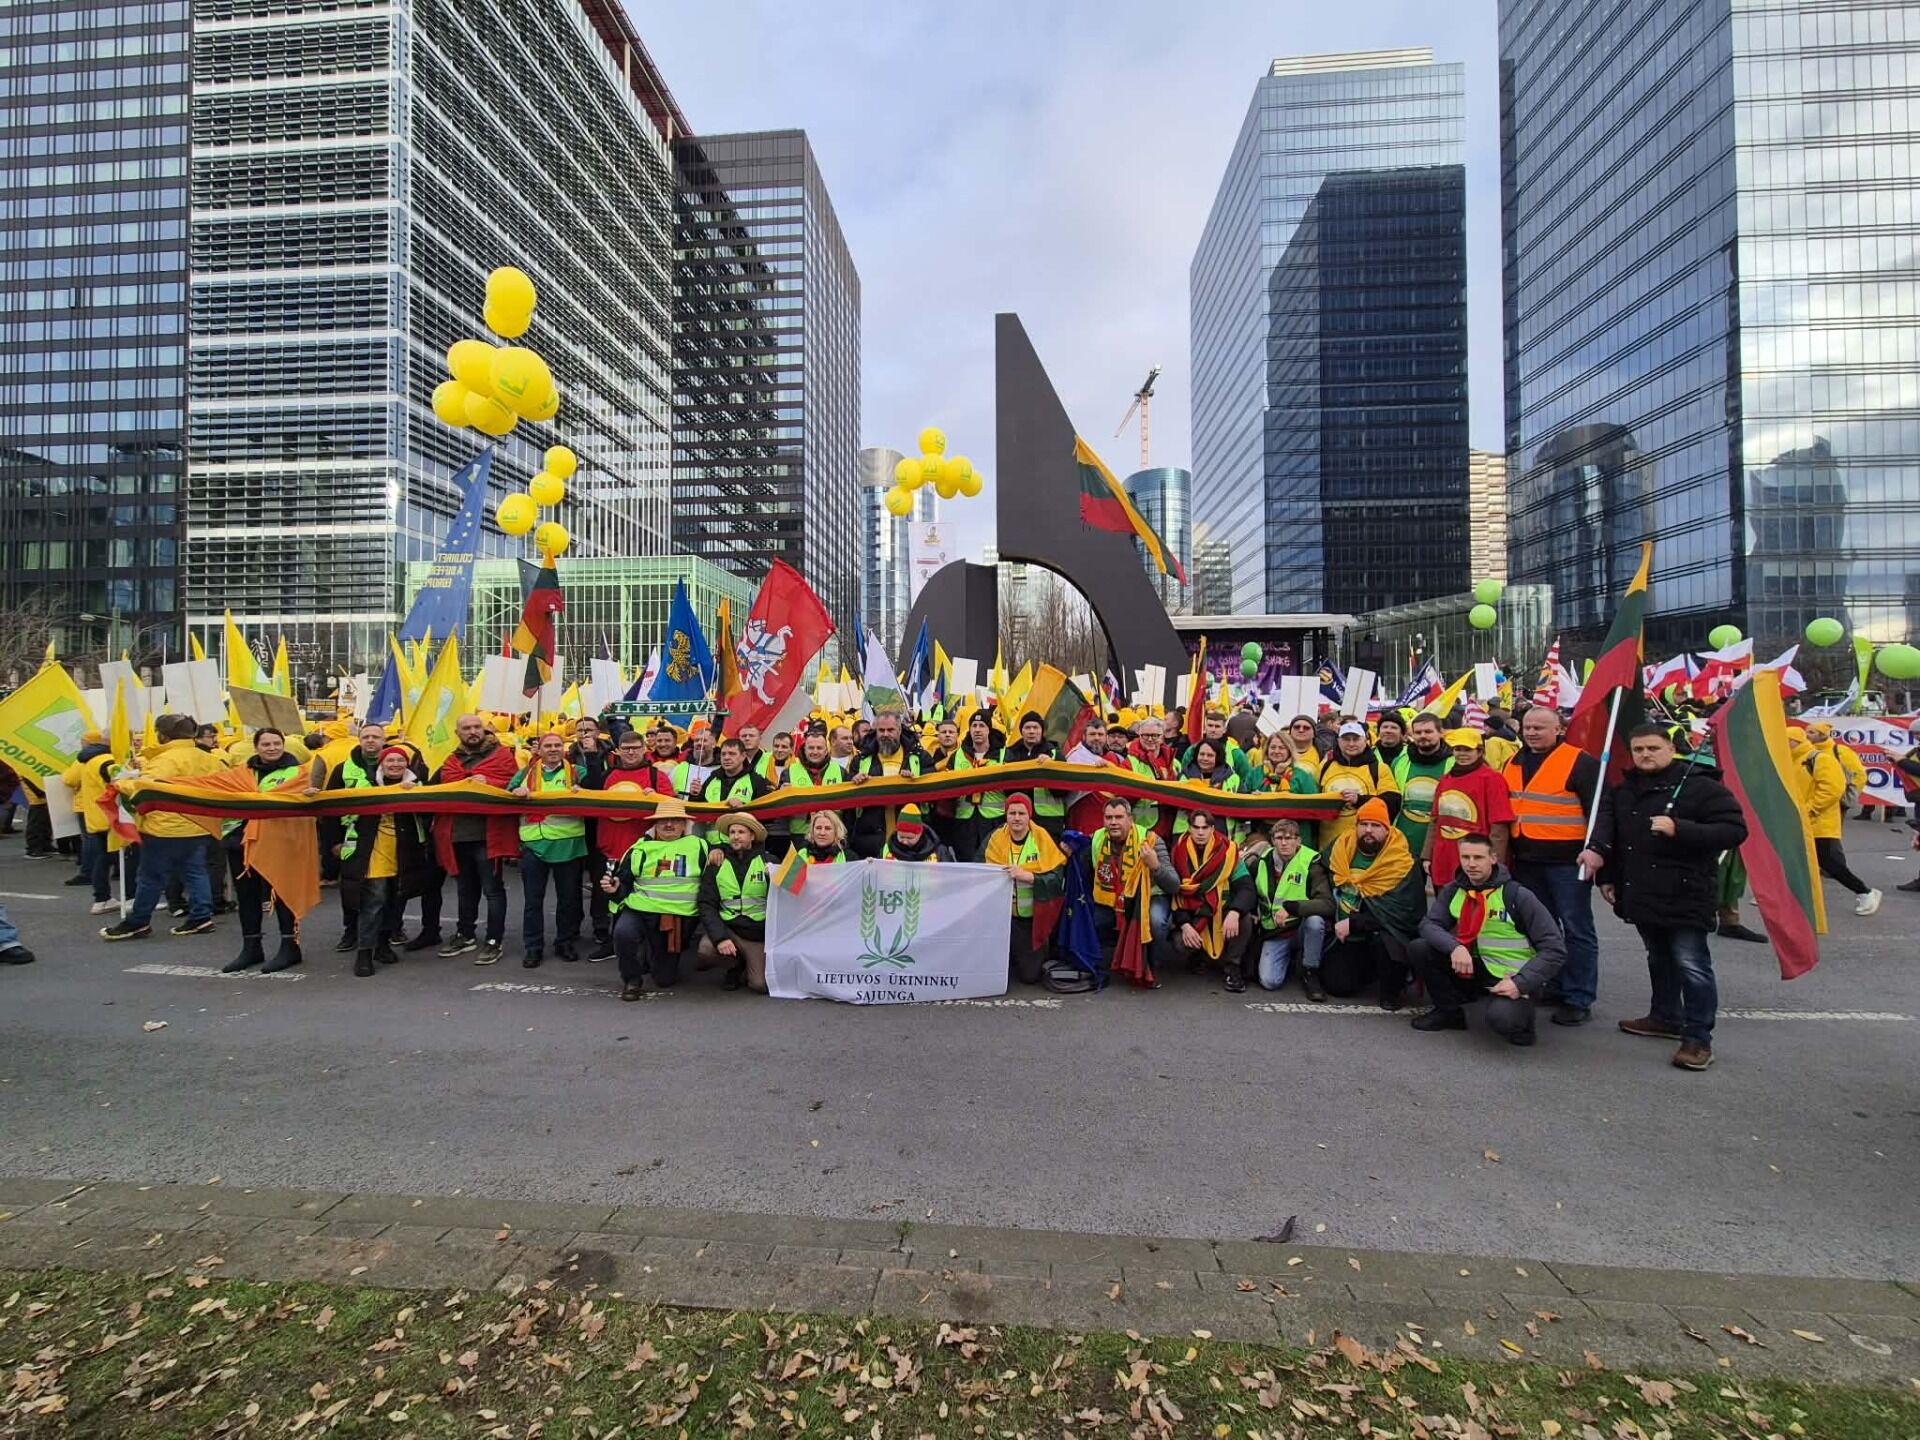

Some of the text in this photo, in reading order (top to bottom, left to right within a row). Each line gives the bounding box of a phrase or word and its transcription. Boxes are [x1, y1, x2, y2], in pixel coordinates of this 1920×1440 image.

[614, 702, 717, 713] LIETUVA
[816, 973, 960, 989] LIETUVOS ŪKININKŲ
